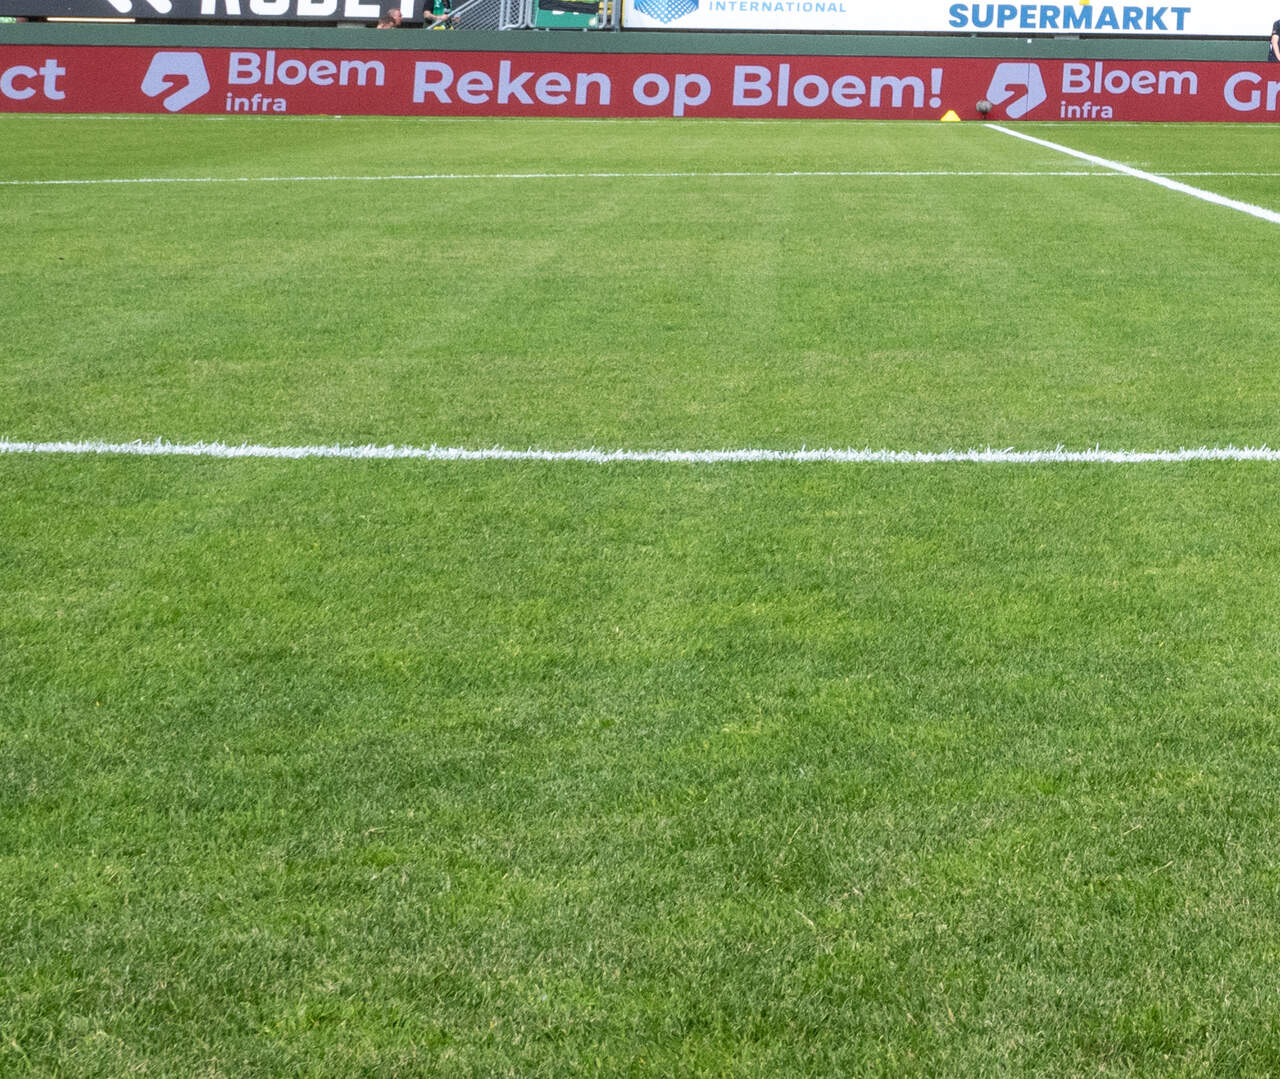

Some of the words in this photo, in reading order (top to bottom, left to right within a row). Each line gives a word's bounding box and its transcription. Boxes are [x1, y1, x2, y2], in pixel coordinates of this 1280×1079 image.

[709, 0, 847, 13] INTERNATIONAL
[948, 3, 1191, 31] SUPERMARKT
[226, 50, 385, 86] Bloem
[1061, 62, 1198, 96] Bloem
[225, 92, 287, 112] infra
[412, 59, 611, 106] Reken
[632, 72, 711, 117] op
[732, 63, 943, 110] Bloem!
[1060, 100, 1113, 119] infra
